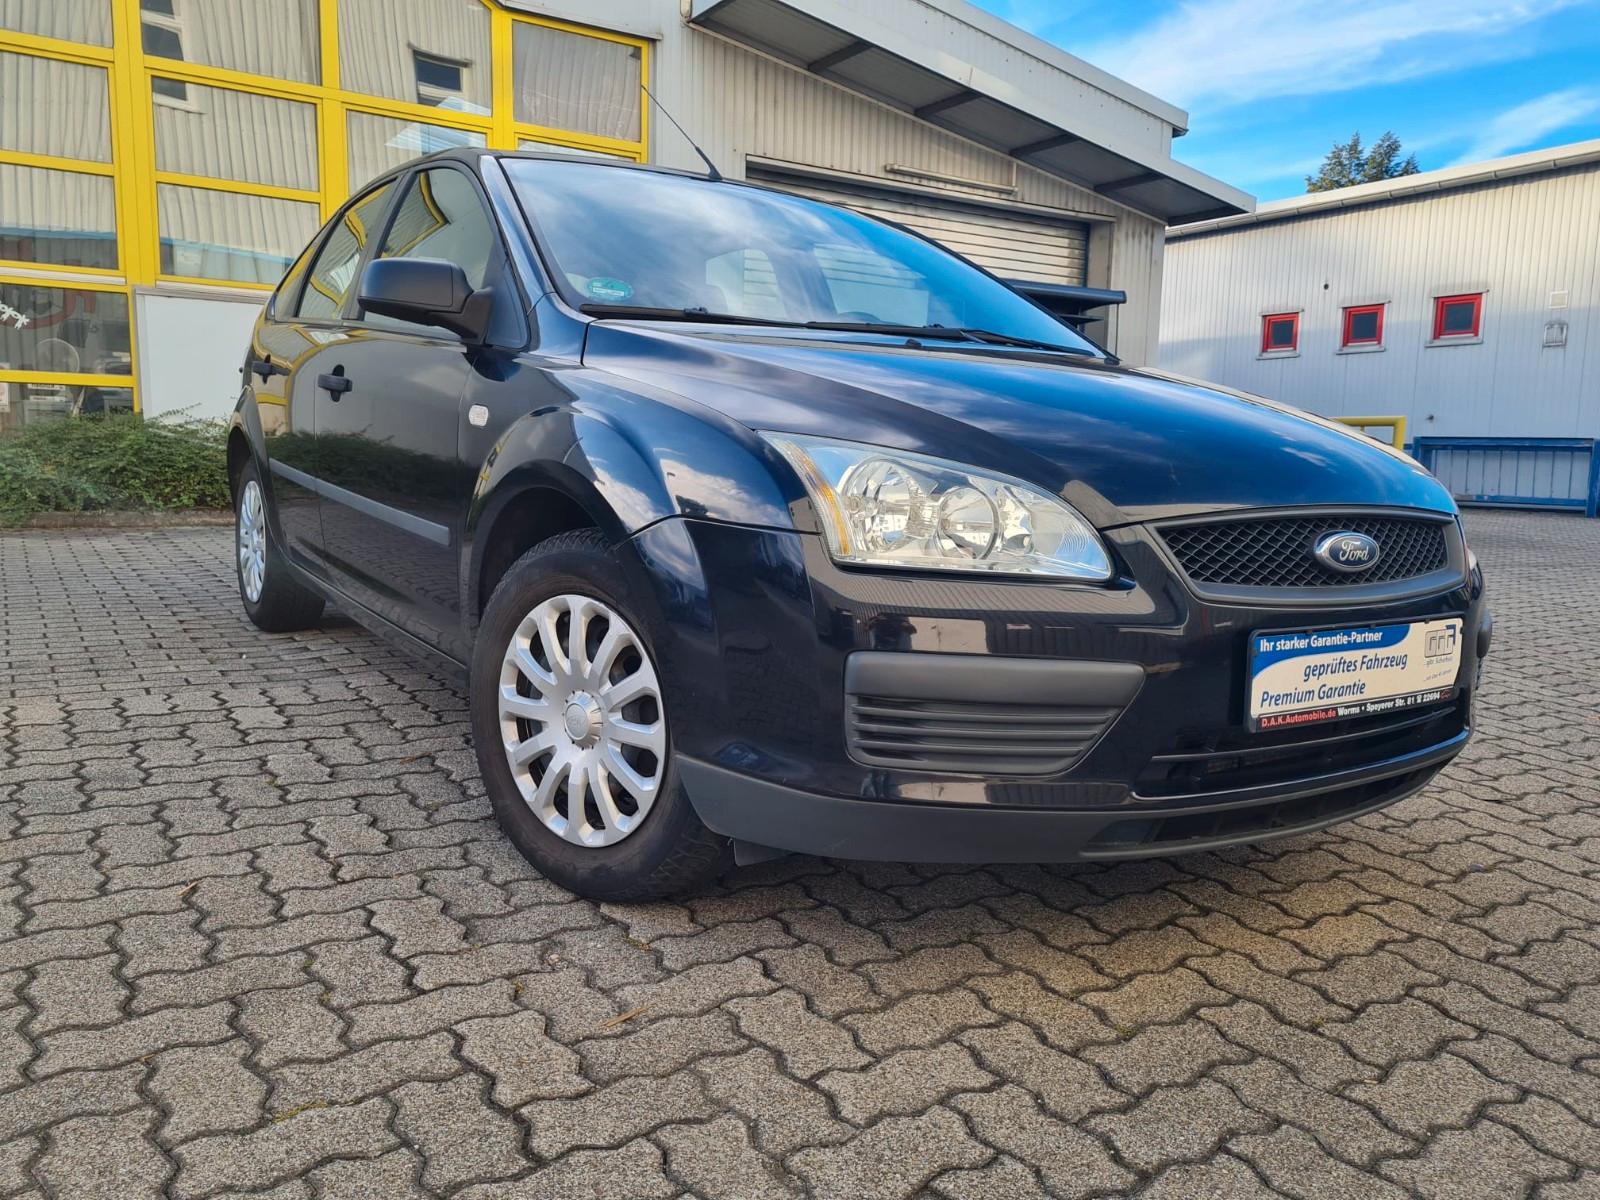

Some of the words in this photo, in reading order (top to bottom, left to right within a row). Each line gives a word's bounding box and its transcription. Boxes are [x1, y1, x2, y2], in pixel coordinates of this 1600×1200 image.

[1340, 540, 1369, 561] Ford
[1260, 639, 1274, 652] Ihr
[1276, 636, 1309, 651] starker
[1310, 631, 1383, 647] Garantie-Partner
[1303, 657, 1357, 682] geprüftes
[1360, 653, 1408, 671] Fahrzeug
[1260, 687, 1315, 708] Premium
[1318, 680, 1366, 700] Garantie
[1337, 706, 1360, 716] Worms
[1366, 700, 1394, 712] Speyerer
[1395, 698, 1406, 707] Str.
